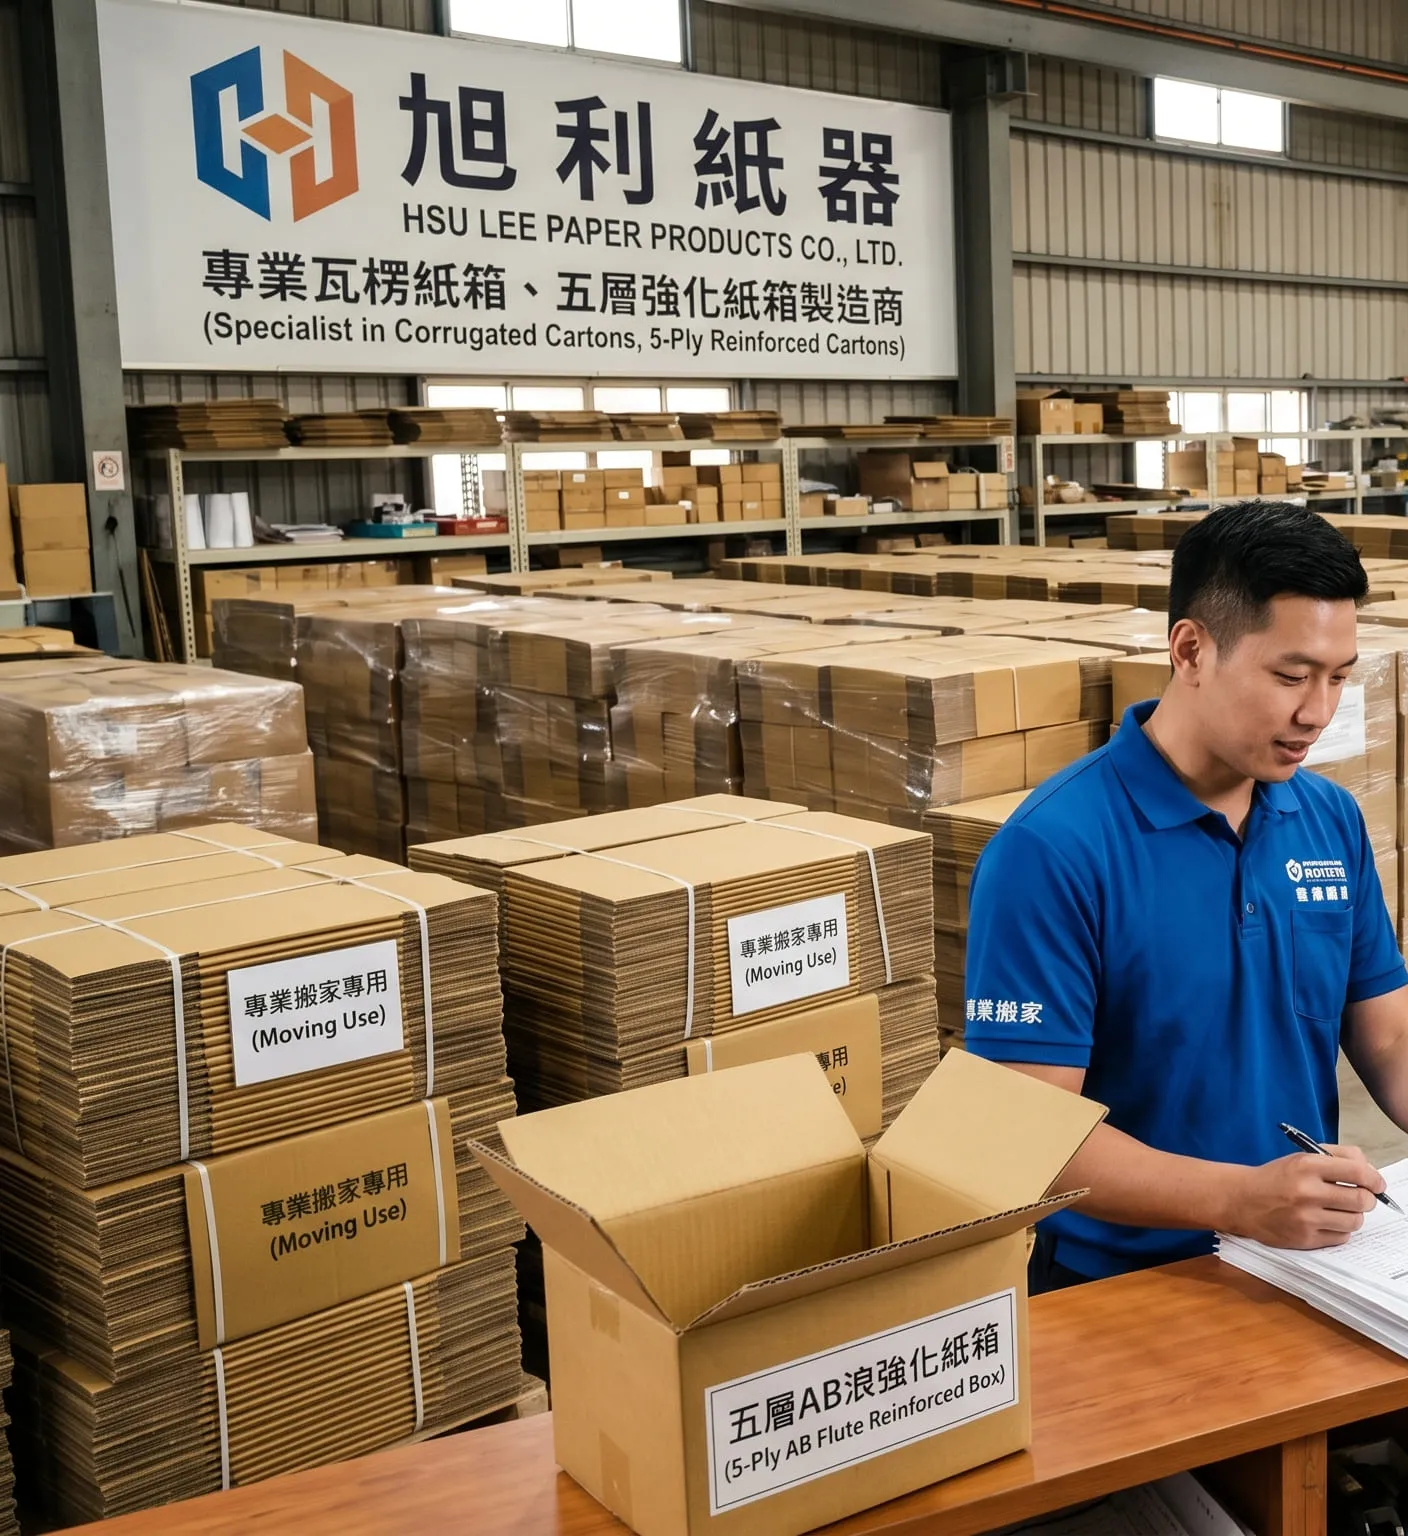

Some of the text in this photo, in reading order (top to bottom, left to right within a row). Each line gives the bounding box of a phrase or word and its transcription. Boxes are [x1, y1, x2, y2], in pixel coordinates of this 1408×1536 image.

[398, 72, 901, 228] 旭利紙器
[403, 202, 904, 267] HSU LEE PAPER PRODUCTS CO., LTD.
[202, 248, 904, 327] 專業瓦楞紙箱、五層強化紙箱製造商
[203, 310, 906, 362] (Specialist in Corrugated Cartons, 5-Ply Reinforced Cartons)
[740, 918, 839, 959] 專業搬家專用
[745, 947, 838, 987] (Moving Use)
[243, 968, 389, 1019] 專業搬家專用
[251, 1004, 387, 1053] (Moving Use)
[260, 1162, 410, 1226] 專業搬家專用
[270, 1199, 408, 1262] (Moving Use)
[728, 1321, 1000, 1445] 五層AB浪強化紙箱
[724, 1364, 1007, 1485] (5-Ply AB Flute Reinforced Box)
